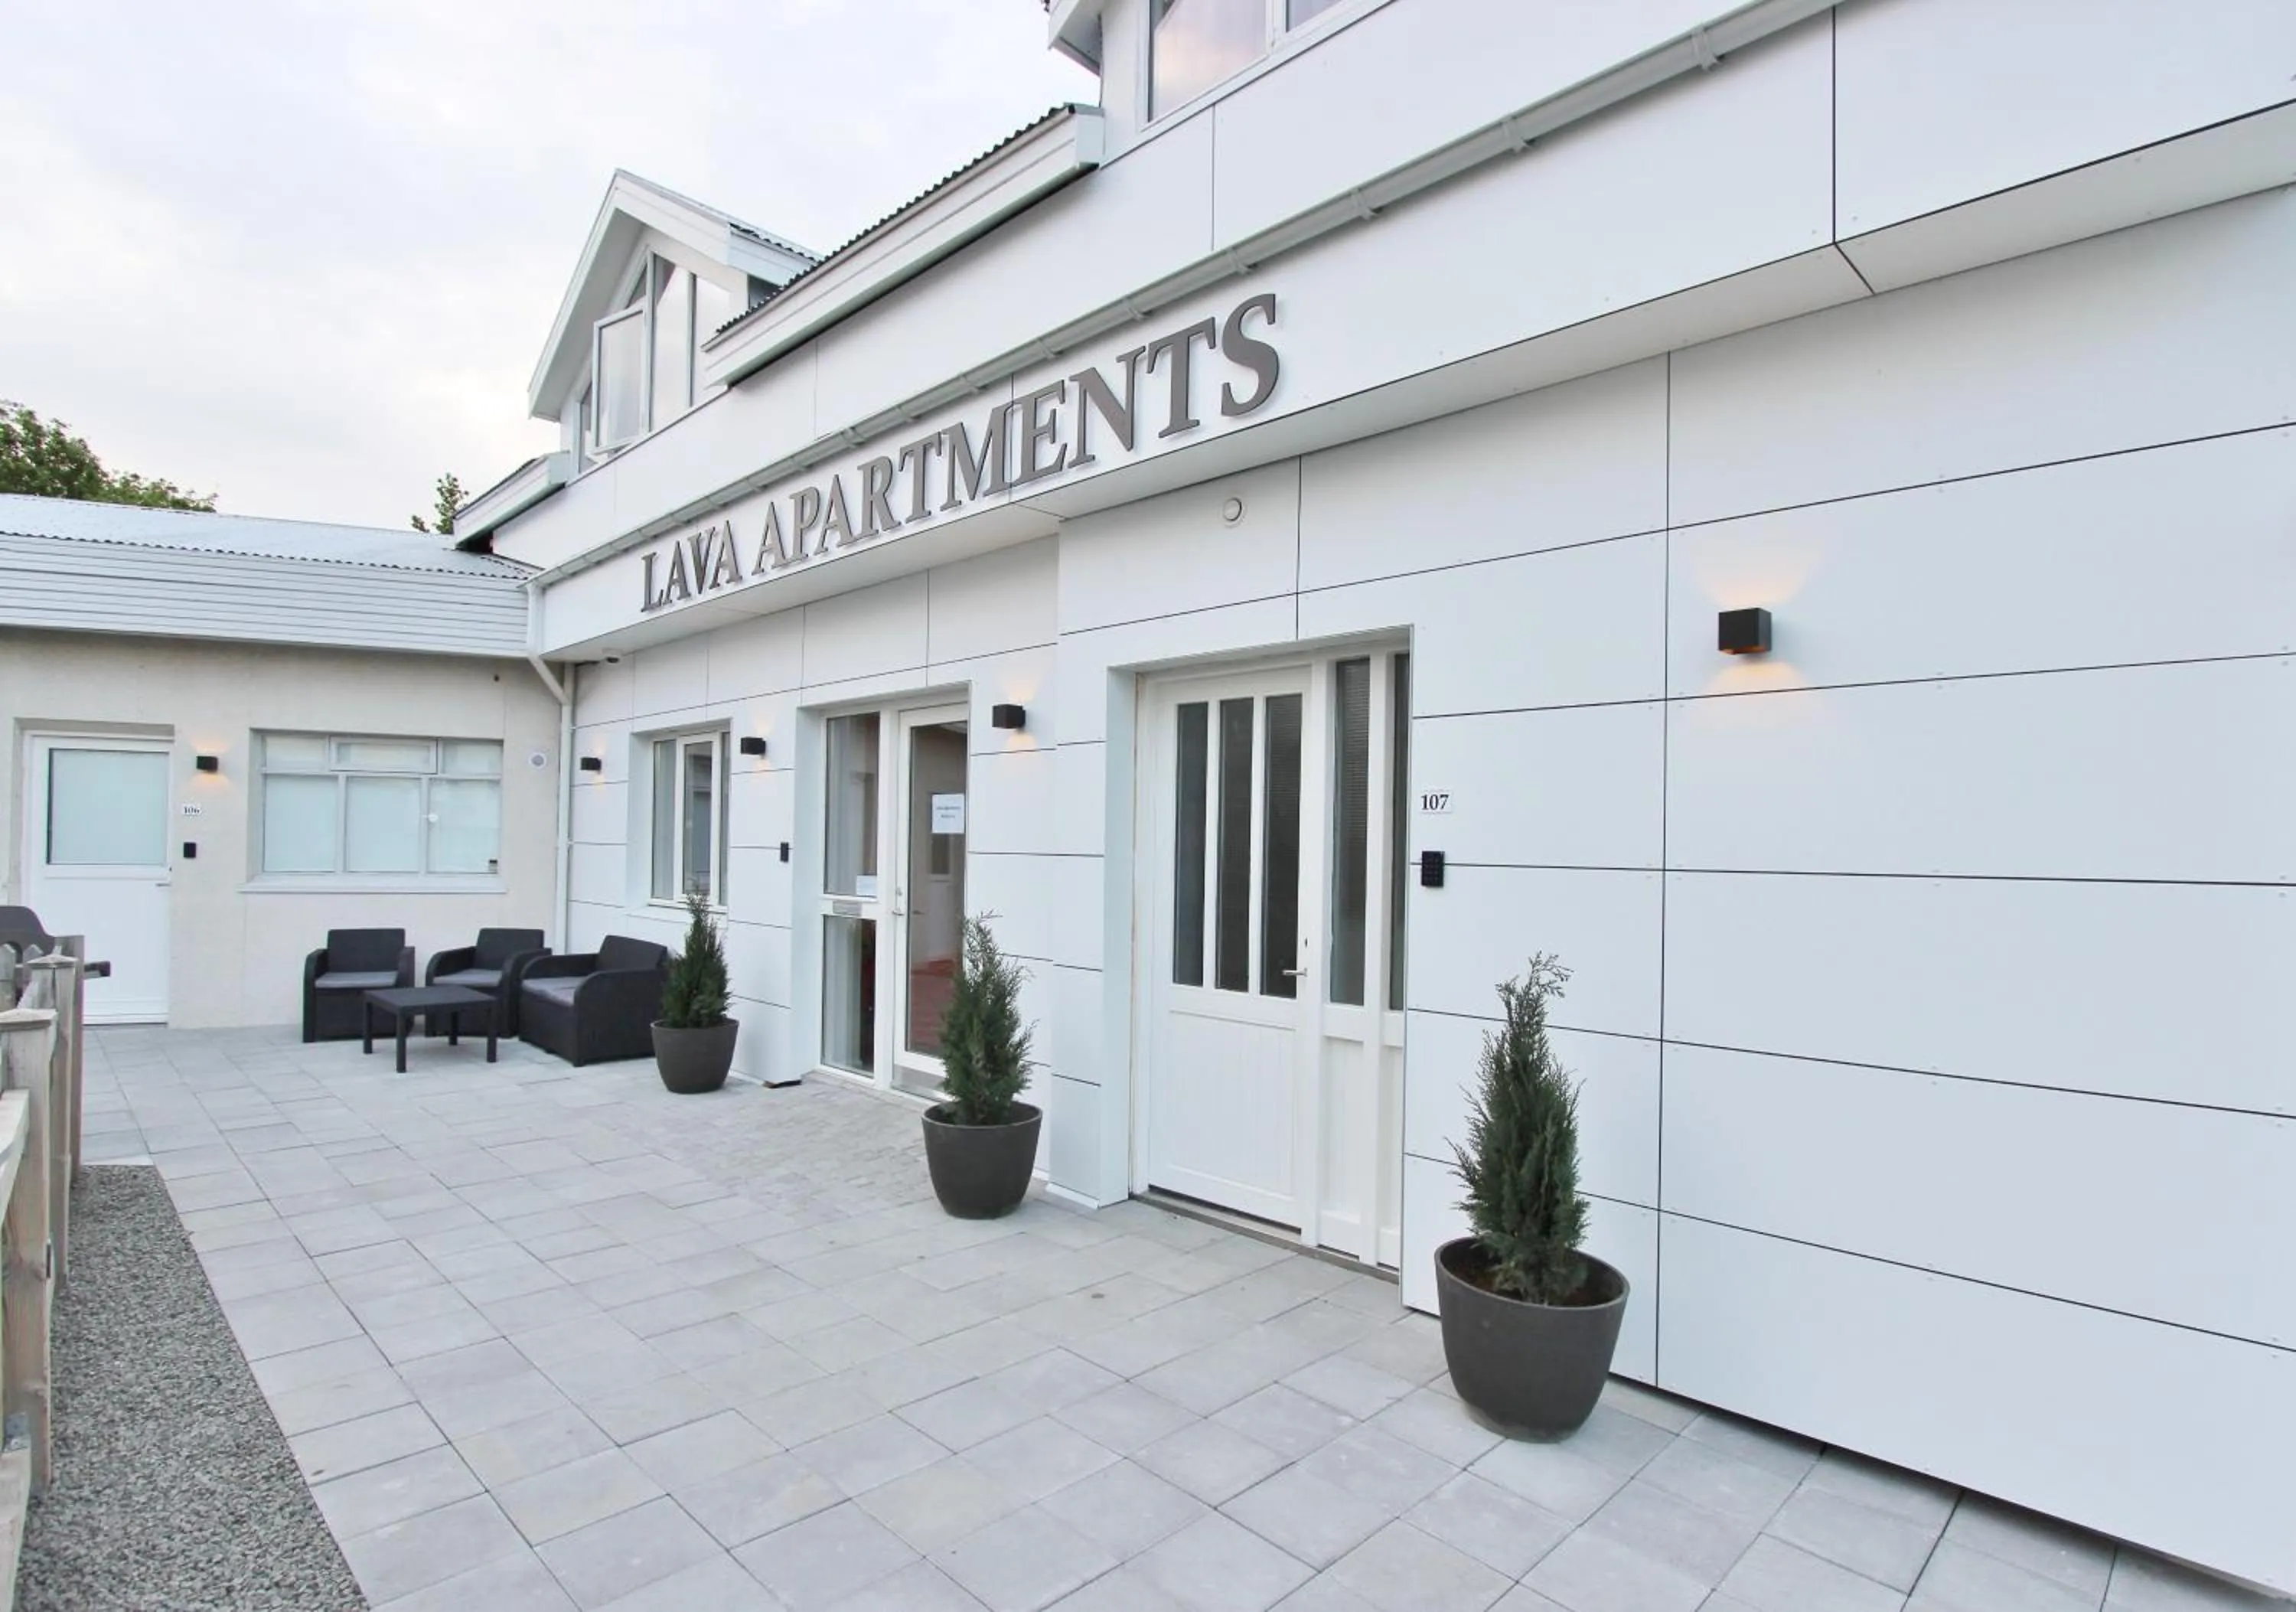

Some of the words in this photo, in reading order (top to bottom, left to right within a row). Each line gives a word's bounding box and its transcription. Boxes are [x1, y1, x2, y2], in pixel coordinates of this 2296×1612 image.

[641, 520, 742, 612] LAVA
[752, 293, 1281, 576] APARTMENTS
[1421, 794, 1450, 811] 107
